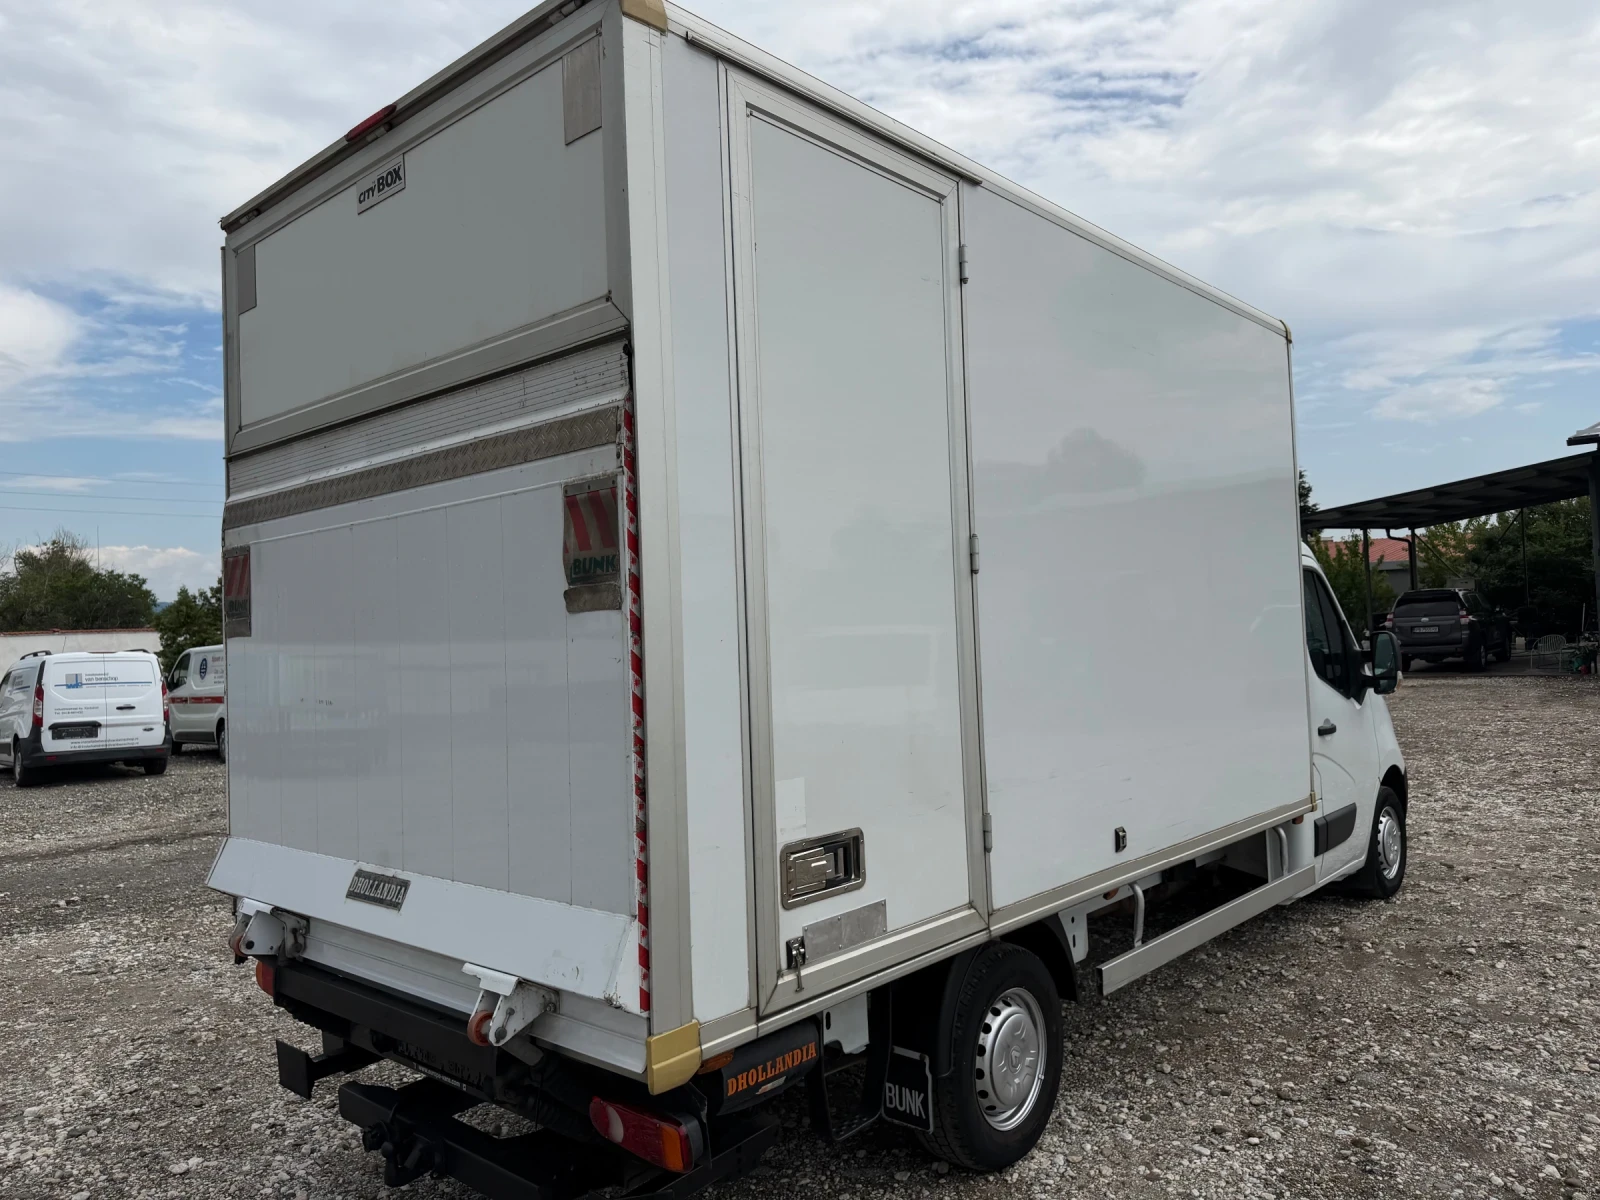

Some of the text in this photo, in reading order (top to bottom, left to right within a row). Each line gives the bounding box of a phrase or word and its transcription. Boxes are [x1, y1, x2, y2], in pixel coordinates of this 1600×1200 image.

[358, 164, 402, 204] CITY BOX
[573, 555, 616, 575] BUNK
[229, 600, 248, 612] BUNK
[349, 876, 406, 903] DHOLLANDIA
[727, 1041, 817, 1097] DHOLLANDIA
[885, 1082, 926, 1120] BUNK
